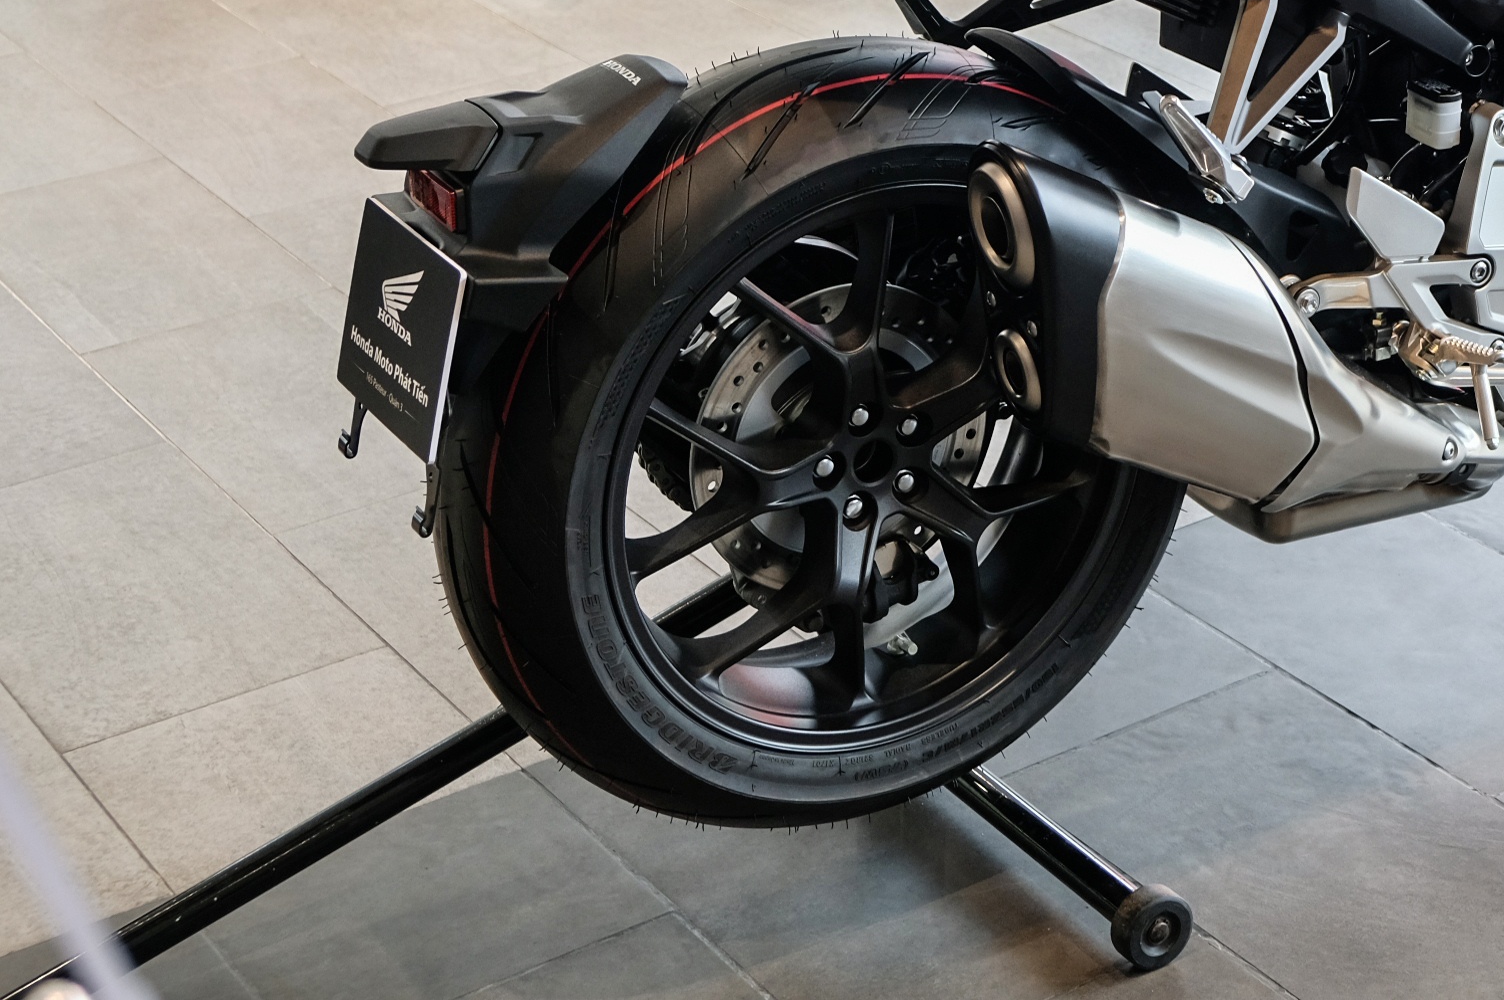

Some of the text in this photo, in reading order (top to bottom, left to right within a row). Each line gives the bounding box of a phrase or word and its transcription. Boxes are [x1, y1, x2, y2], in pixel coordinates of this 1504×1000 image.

[601, 60, 641, 86] HONDA
[377, 306, 412, 347] HONDA
[350, 325, 429, 408] Honda Moto Phát Tiến
[581, 593, 737, 774] BRIDGESTONE
